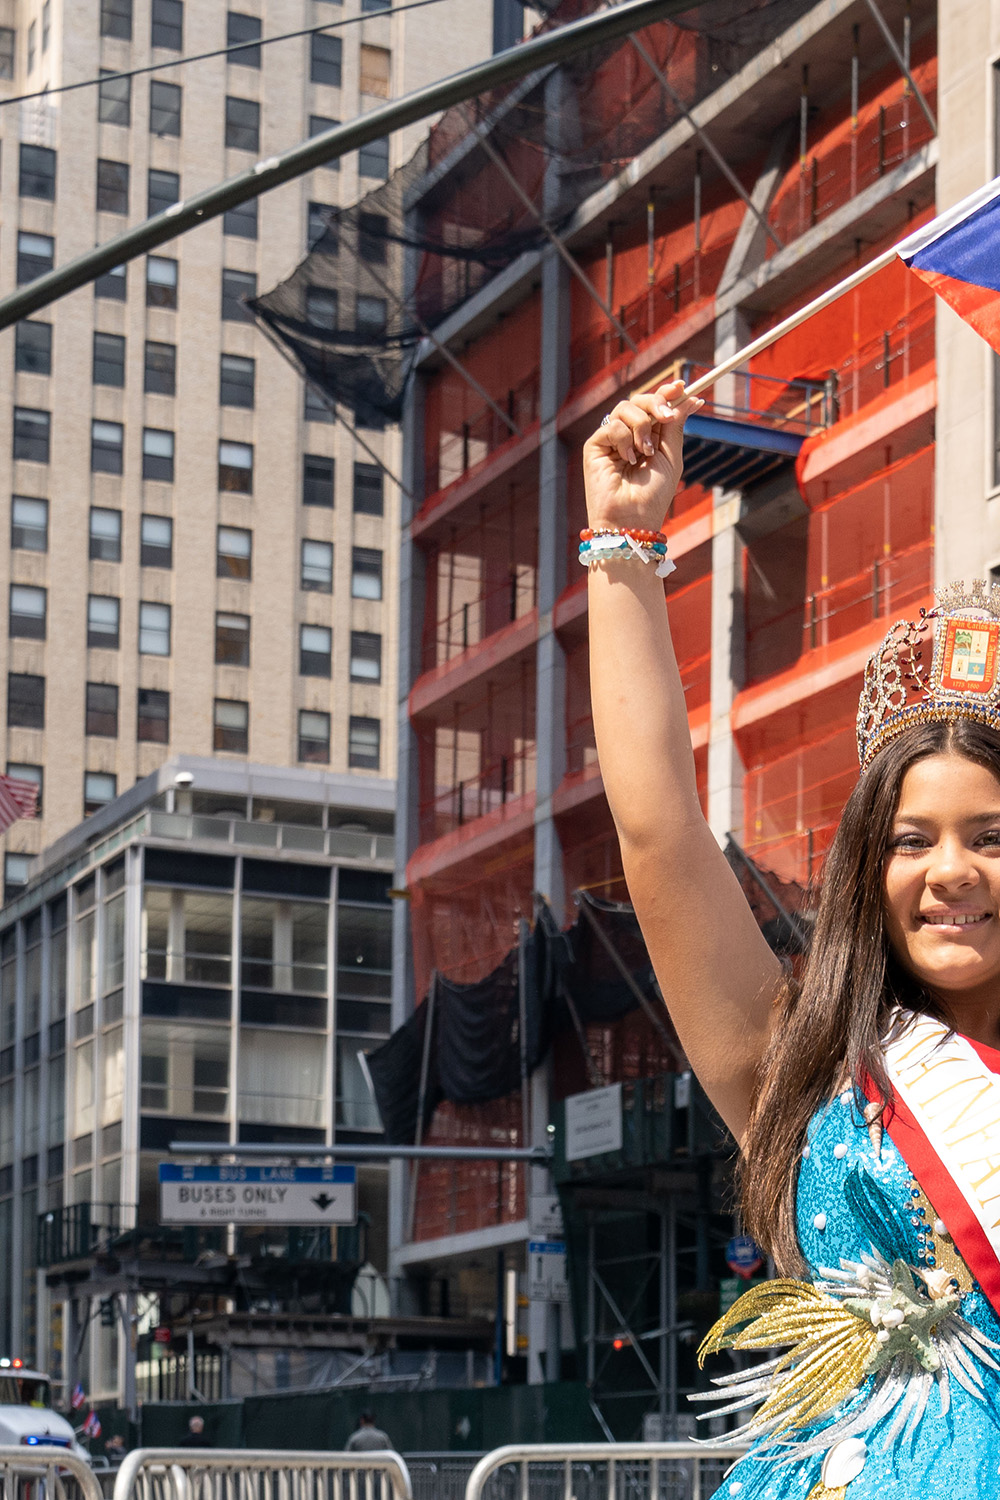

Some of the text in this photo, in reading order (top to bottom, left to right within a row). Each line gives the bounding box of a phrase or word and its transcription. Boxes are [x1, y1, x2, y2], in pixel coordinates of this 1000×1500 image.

[967, 622, 988, 630] Carlos
[989, 623, 997, 631] de
[948, 631, 955, 639] de
[945, 641, 953, 659] Villa
[985, 644, 996, 683] Aguadilla
[219, 1167, 297, 1181] BUS LANE
[178, 1186, 288, 1204] BUSES ONLY
